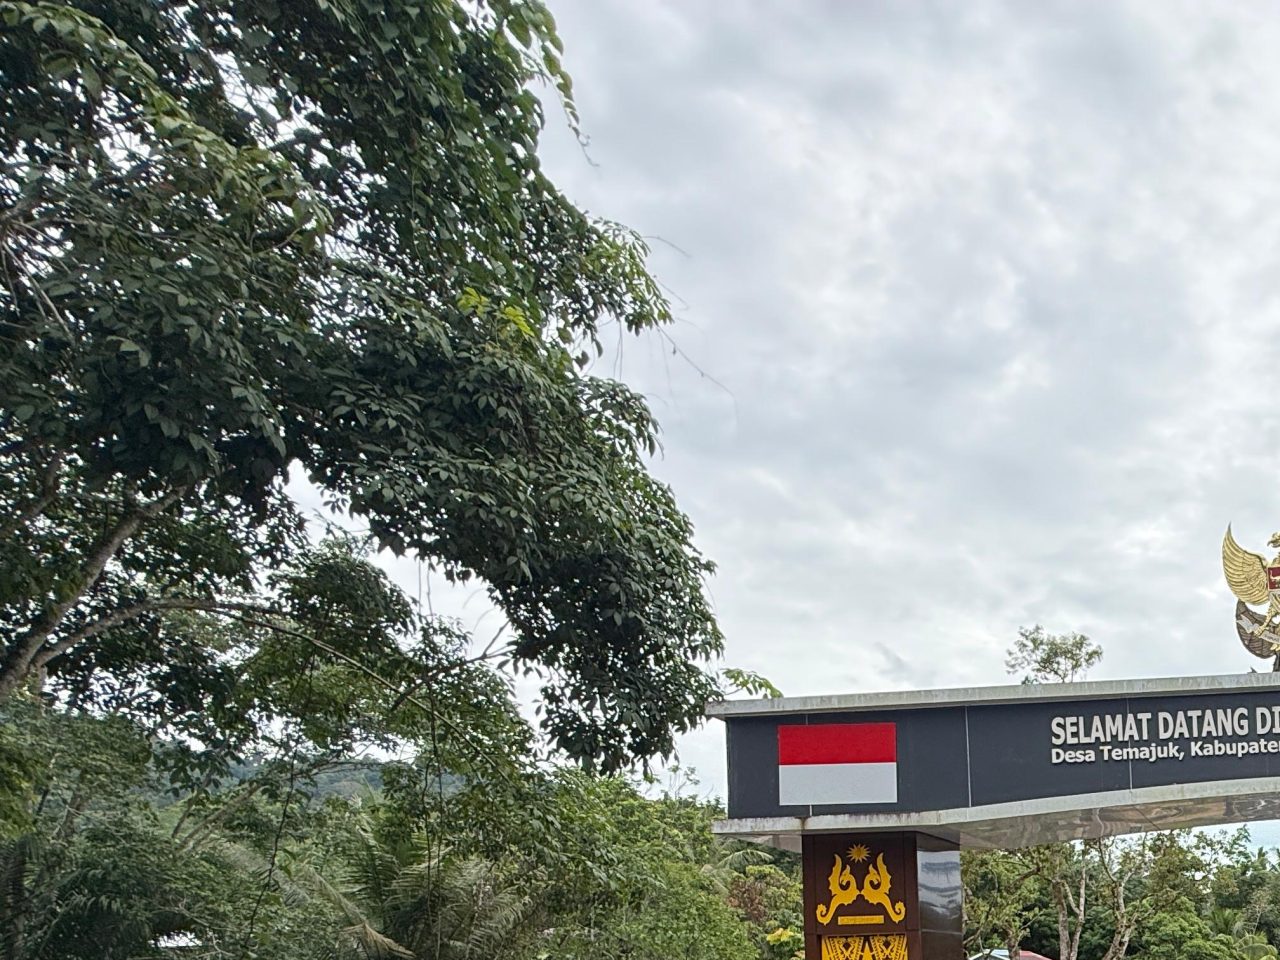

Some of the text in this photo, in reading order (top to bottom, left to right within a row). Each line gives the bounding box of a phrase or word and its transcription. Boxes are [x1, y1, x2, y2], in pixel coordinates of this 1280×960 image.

[1051, 712, 1152, 745] SELAMAT
[1158, 707, 1249, 739] DATANG
[1051, 747, 1096, 764] Desa
[1099, 743, 1185, 762] Temajuk,
